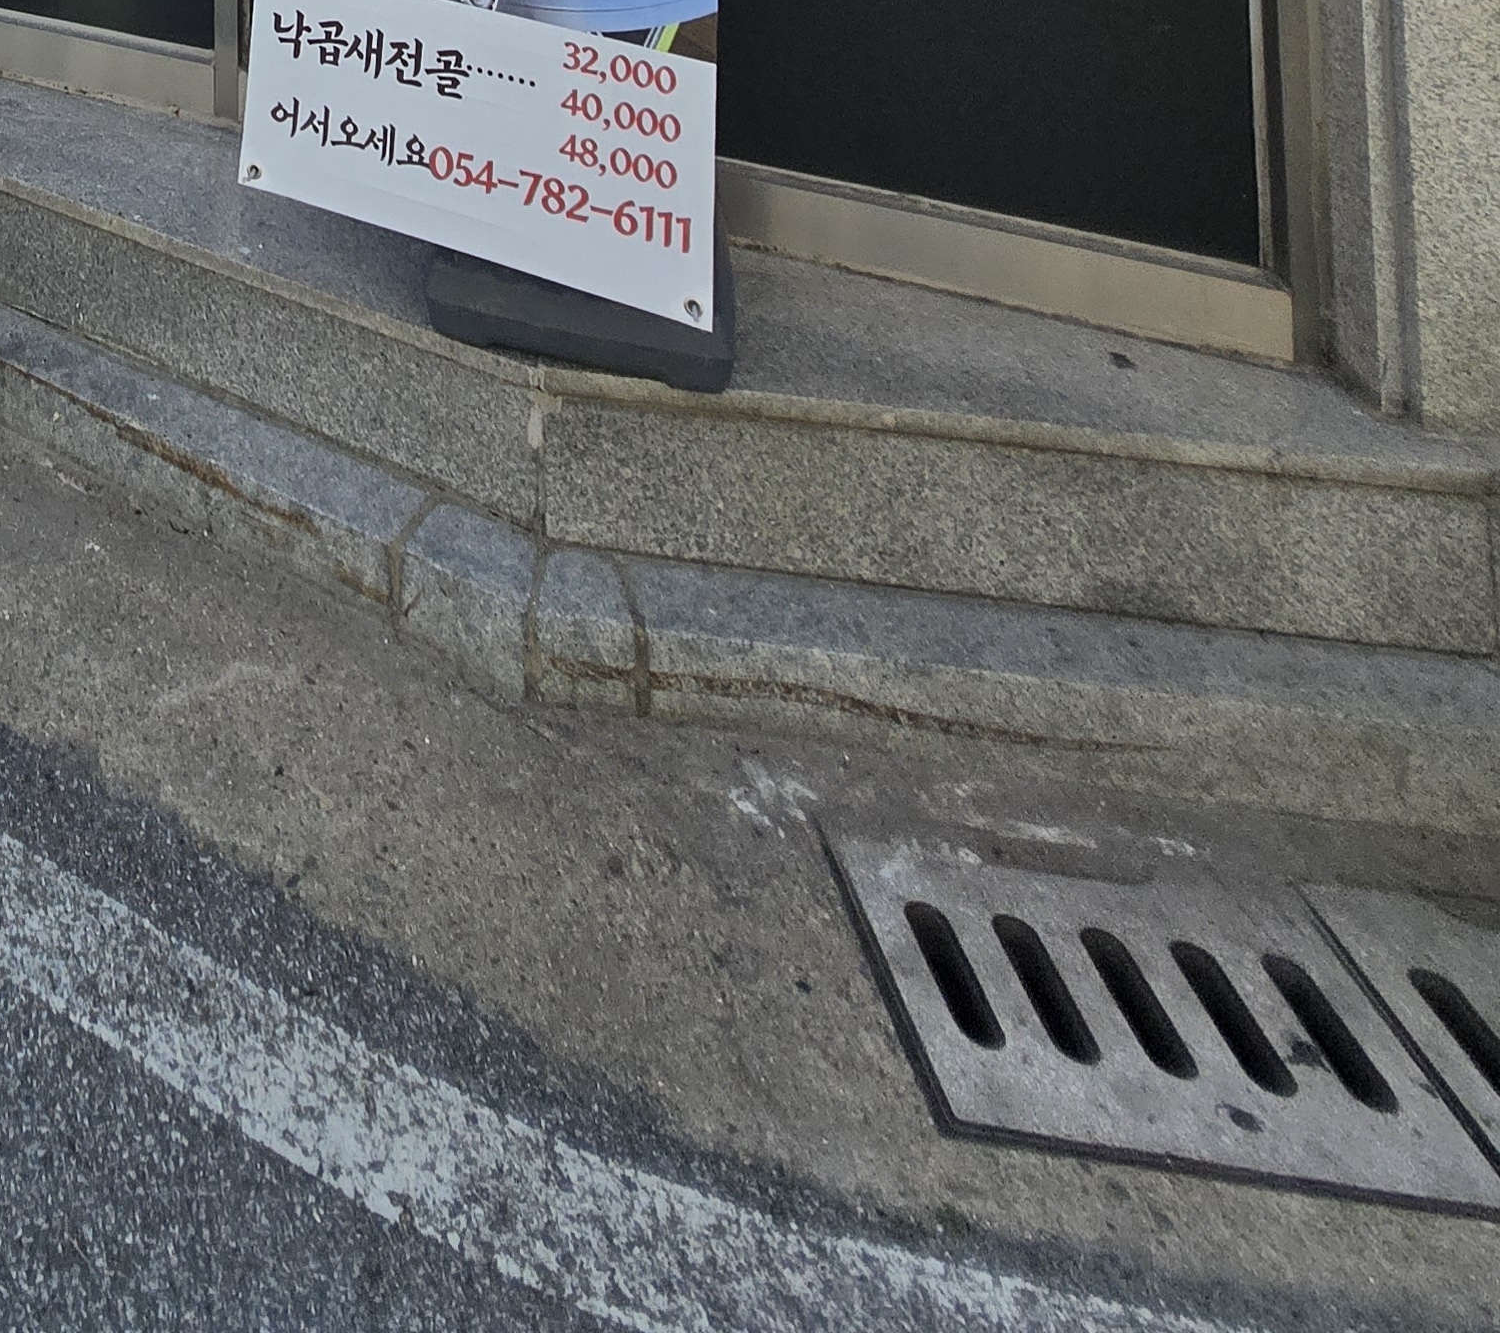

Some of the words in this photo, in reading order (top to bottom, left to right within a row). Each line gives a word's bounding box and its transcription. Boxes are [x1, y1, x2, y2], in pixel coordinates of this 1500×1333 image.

[273, 9, 471, 100] 낙곱새전골
[562, 41, 678, 95] 32,000
[560, 89, 682, 143] 40,000
[270, 97, 431, 169] 어서오세요
[428, 146, 693, 254] 054-782-6111
[559, 134, 679, 190] 48,000
